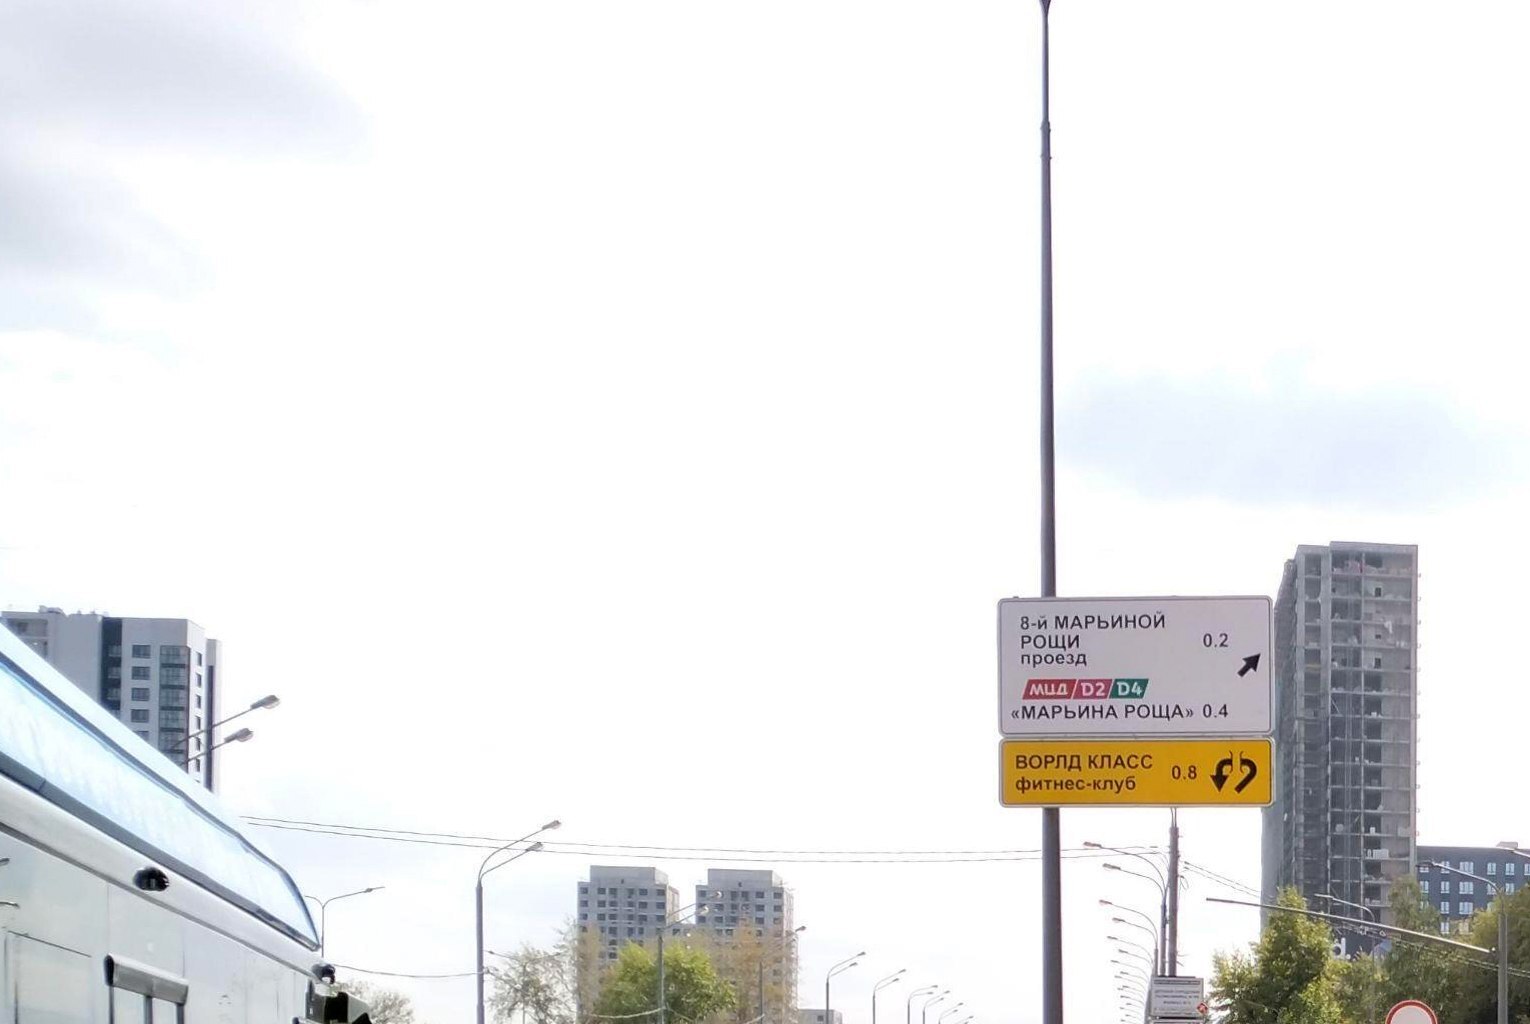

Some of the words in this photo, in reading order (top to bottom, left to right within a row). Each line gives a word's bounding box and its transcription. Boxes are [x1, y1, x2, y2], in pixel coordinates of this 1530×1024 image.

[1020, 615, 1048, 630] 8-й
[1054, 611, 1166, 630] МАРЬИНОЙ
[1020, 635, 1080, 652] РОЩИ
[1203, 633, 1229, 648] 0.2
[1020, 653, 1087, 667] проезд
[1029, 683, 1069, 696] МЦД
[1080, 683, 1106, 697] D2
[1116, 682, 1144, 697] D4
[1011, 704, 1118, 720] «МАРЬИНА
[1125, 704, 1194, 721] РОЩА»
[1202, 703, 1229, 718] 0.4
[1015, 754, 1082, 772] ВОРЛД
[1088, 754, 1153, 769] КЛАСС
[1171, 765, 1197, 780] 0.8
[1015, 776, 1136, 794] фитнес-клуб
